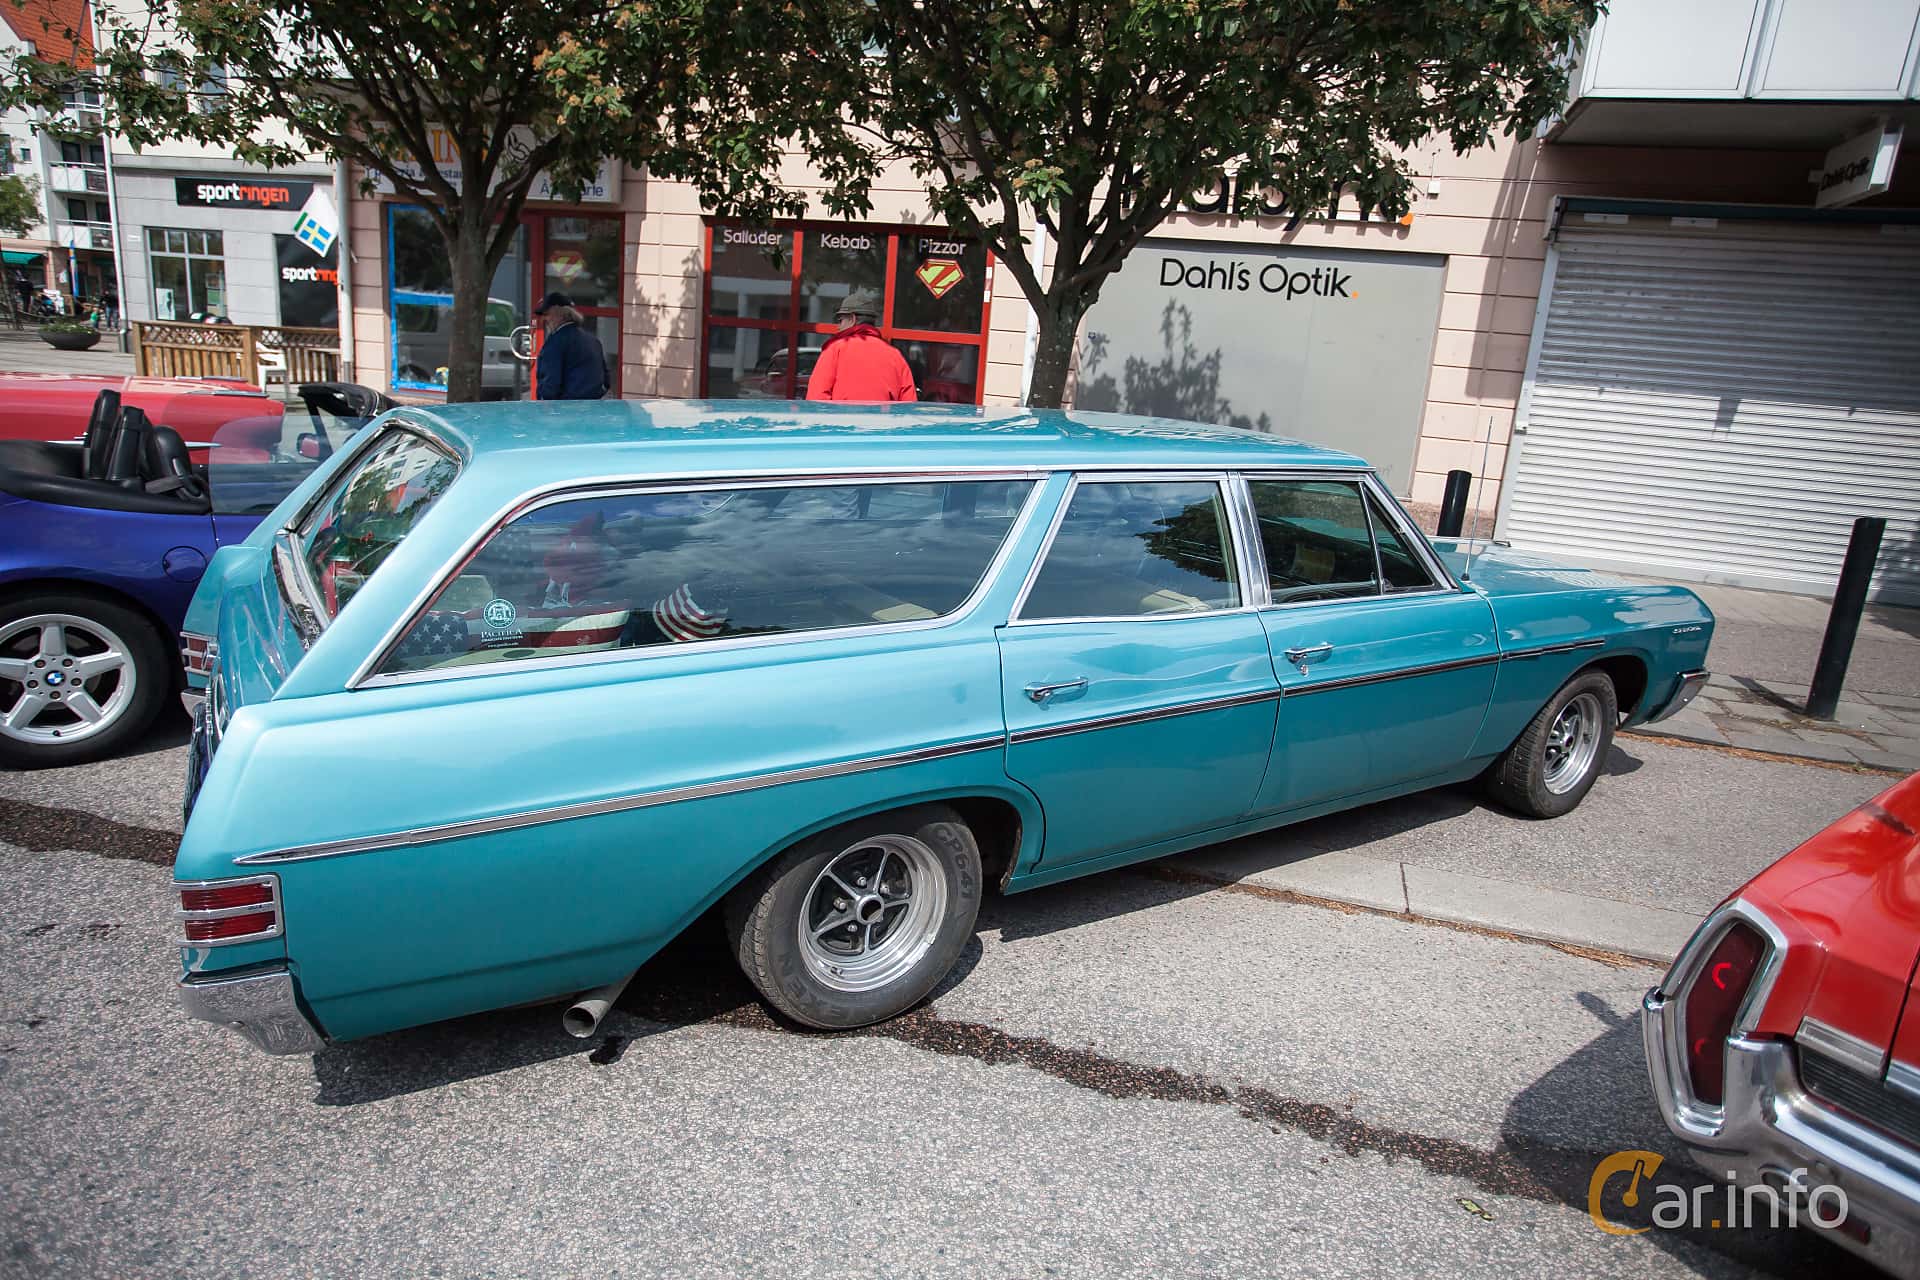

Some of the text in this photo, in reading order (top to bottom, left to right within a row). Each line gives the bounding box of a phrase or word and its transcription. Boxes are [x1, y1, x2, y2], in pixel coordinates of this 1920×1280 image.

[197, 183, 289, 206] sportringen
[723, 228, 783, 246] Sallader
[820, 233, 871, 250] Kebab
[918, 238, 967, 256] Pizzor
[282, 266, 338, 286] sportring
